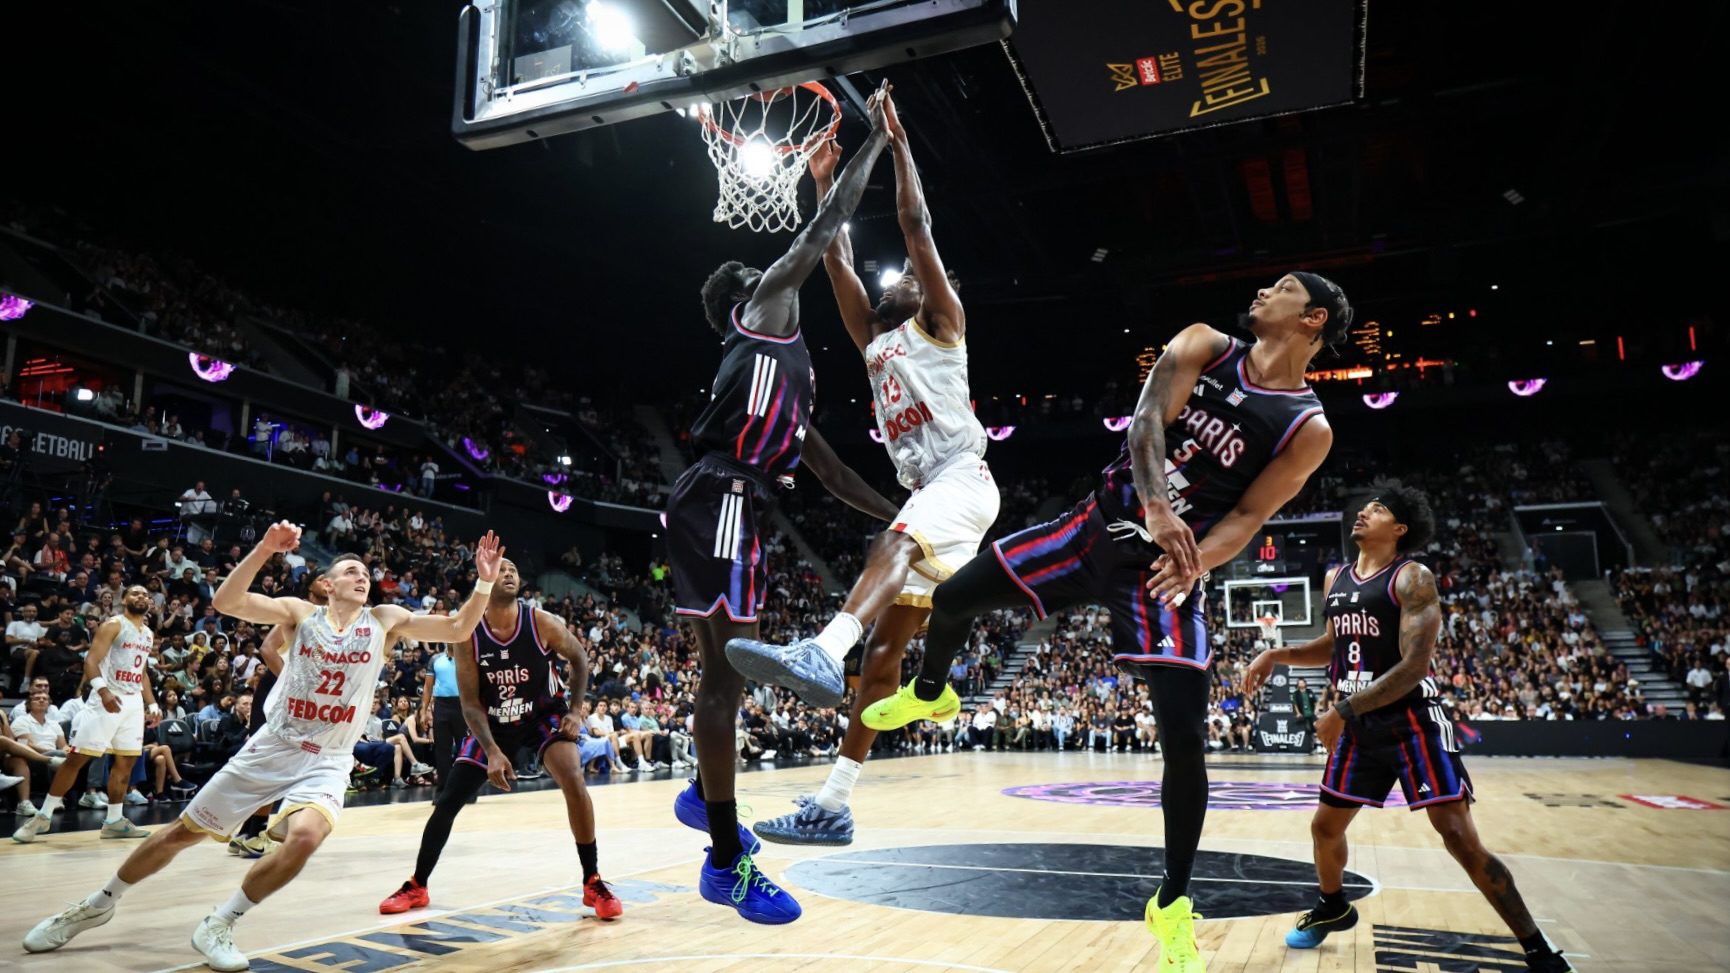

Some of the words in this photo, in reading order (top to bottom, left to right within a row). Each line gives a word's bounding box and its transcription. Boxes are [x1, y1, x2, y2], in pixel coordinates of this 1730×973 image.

[1188, 0, 1254, 105] FINALES
[1260, 546, 1276, 560] 10
[1348, 642, 1360, 664] 8
[315, 670, 346, 696] 22
[486, 667, 529, 685] PARIS
[498, 685, 516, 700] 22
[488, 701, 533, 717] MENNEN
